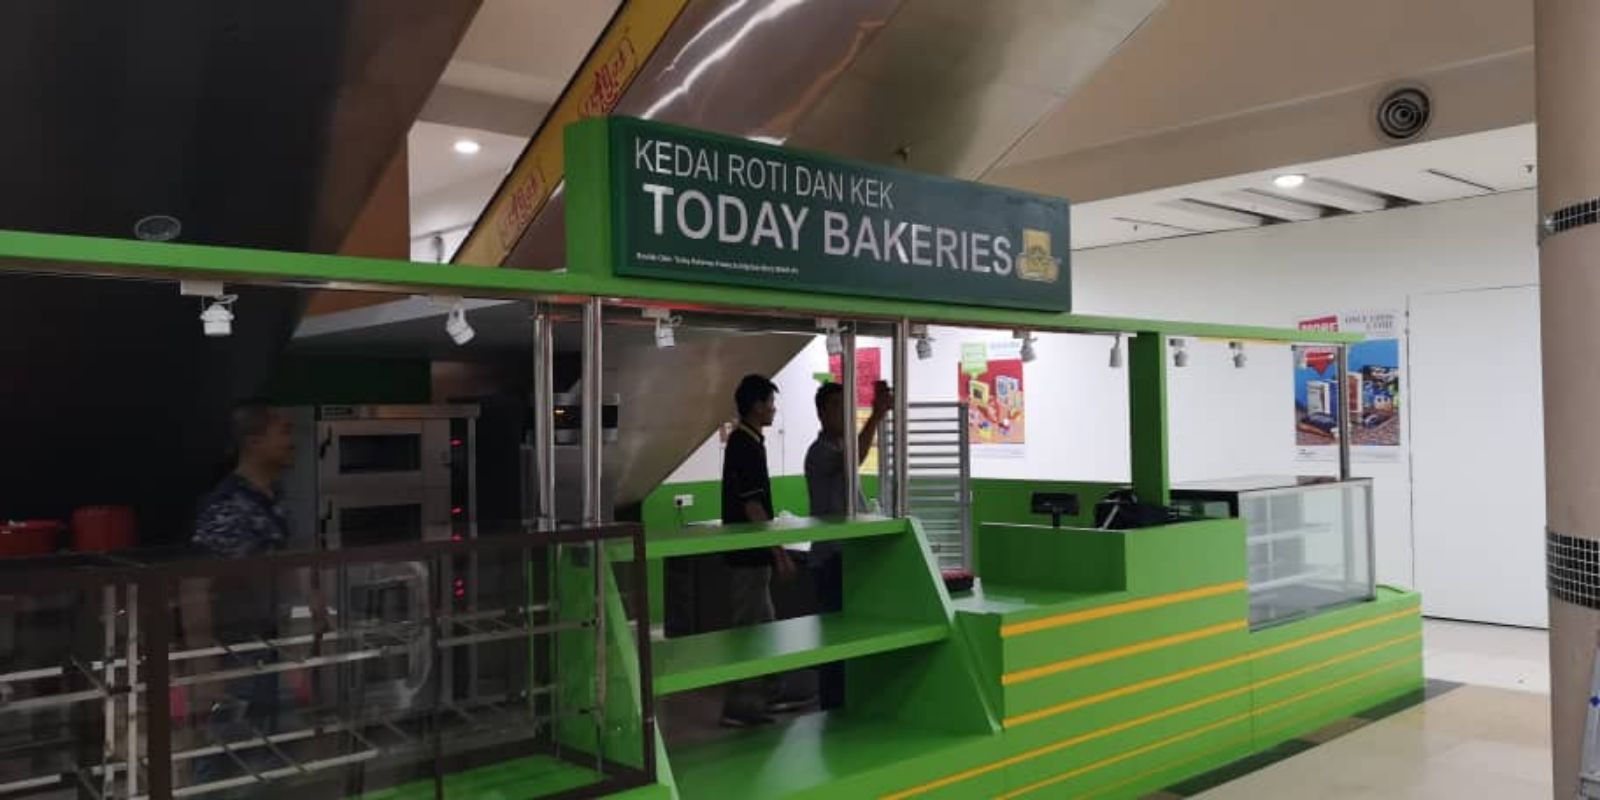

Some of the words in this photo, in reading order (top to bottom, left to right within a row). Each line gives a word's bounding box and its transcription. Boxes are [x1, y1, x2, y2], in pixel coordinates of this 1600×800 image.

[635, 137, 719, 182] KEDAI
[728, 153, 787, 193] ROTI
[795, 166, 843, 202] DAN
[850, 175, 894, 211] KEK
[642, 183, 809, 251] TODAY
[823, 210, 1013, 276] BAKERIES
